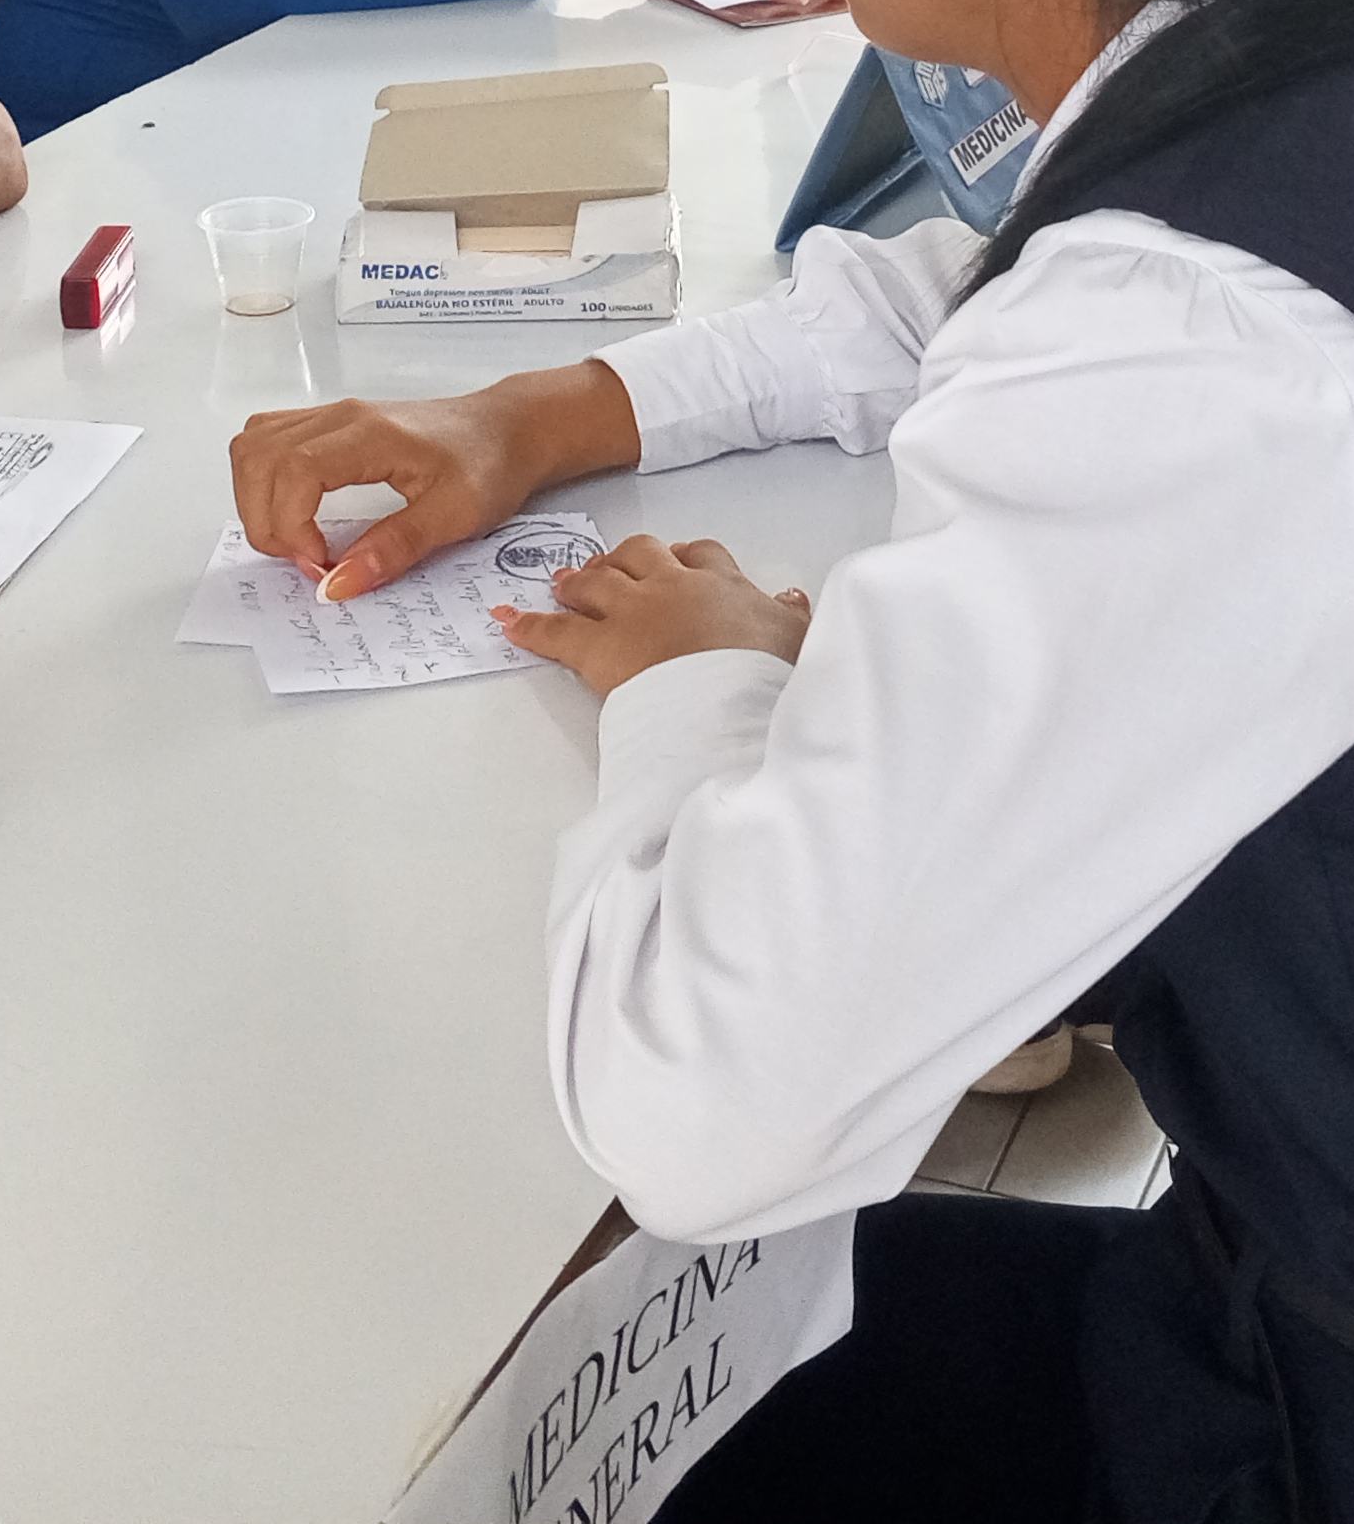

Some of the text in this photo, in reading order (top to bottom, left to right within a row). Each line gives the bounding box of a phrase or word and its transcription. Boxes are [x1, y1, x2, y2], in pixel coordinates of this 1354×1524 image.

[524, 298, 565, 307] ADULTO
[580, 302, 607, 313] 100
[556, 1333, 732, 1524] NERAL
